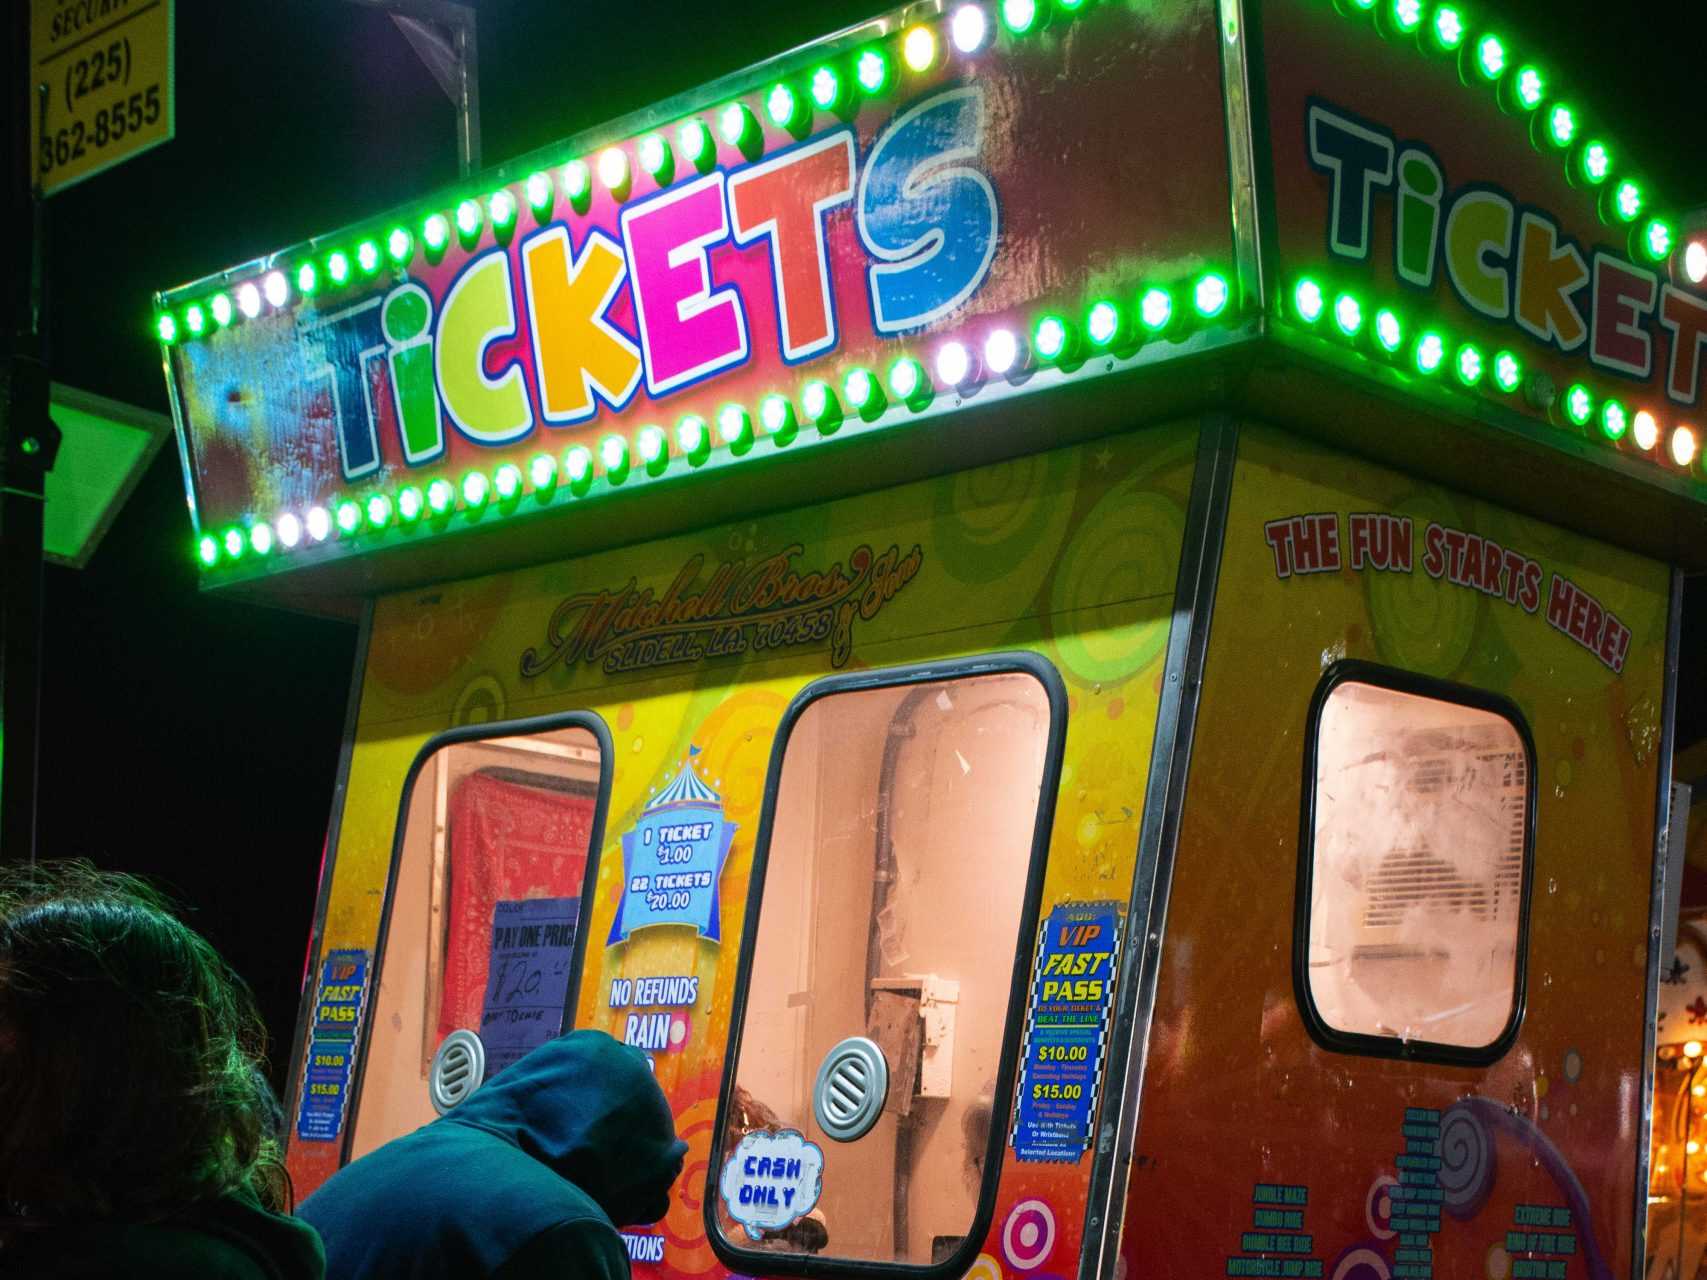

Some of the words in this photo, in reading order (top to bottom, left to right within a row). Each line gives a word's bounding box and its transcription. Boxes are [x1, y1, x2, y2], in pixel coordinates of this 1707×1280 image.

[66, 37, 131, 113] (225)
[39, 84, 160, 172] 362-8555
[1265, 513, 1341, 577] THE
[1348, 513, 1414, 574] FUN
[1421, 522, 1543, 612] STARTS
[1546, 574, 1631, 674] HERE!
[752, 608, 833, 652] 70458
[644, 828, 652, 845] 1
[659, 822, 713, 843] TICKET
[657, 845, 692, 865] $1.00
[631, 876, 650, 892] 22
[654, 870, 712, 890] TICKETS
[646, 889, 690, 911] $20.00
[495, 927, 517, 950] PAY
[520, 925, 541, 948] ONE
[1059, 925, 1101, 947] VIP
[331, 964, 357, 980] VIP
[1043, 952, 1110, 976] FAST
[321, 985, 361, 1002] FAST
[609, 978, 632, 1008] NO
[633, 976, 698, 1007] REFUNDS
[1042, 980, 1103, 1002] PASS
[319, 1006, 356, 1023] PASS
[623, 1013, 672, 1051] RAIN
[315, 1055, 344, 1067] $10.00
[1039, 1046, 1087, 1061] $10.00
[310, 1083, 340, 1096] $15.00
[1033, 1084, 1082, 1099] $15.00
[744, 1156, 800, 1178] CASH
[739, 1185, 795, 1206] ONLY
